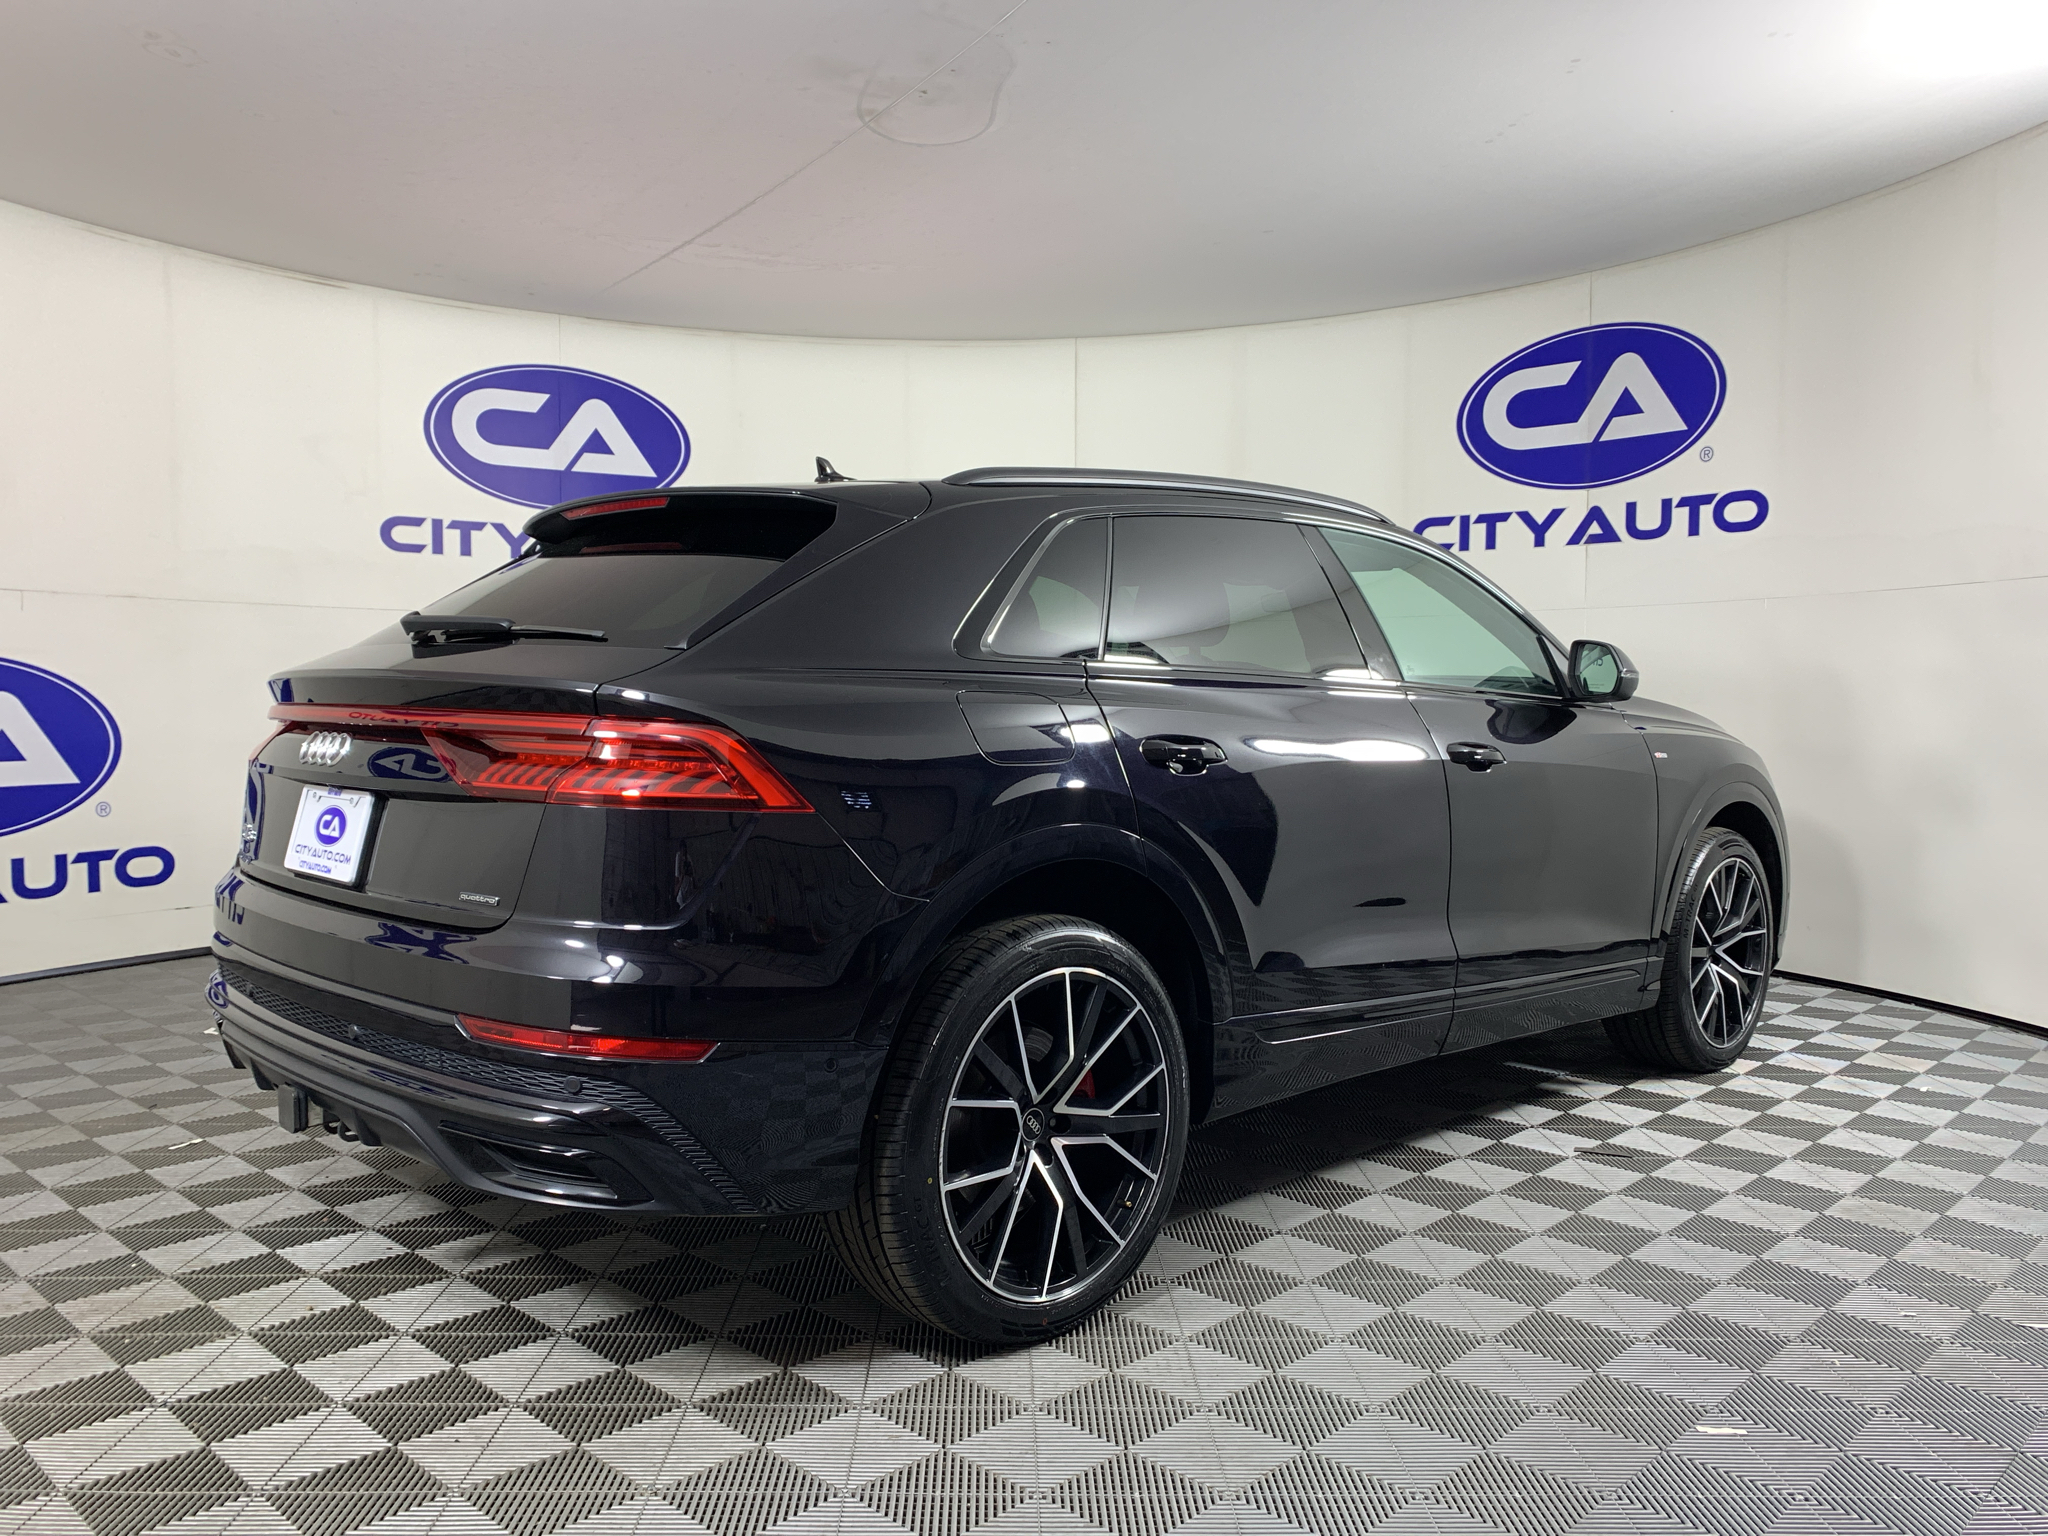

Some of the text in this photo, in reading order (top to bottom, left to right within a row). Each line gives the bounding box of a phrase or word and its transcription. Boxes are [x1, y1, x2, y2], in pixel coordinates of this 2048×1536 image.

[1482, 351, 1689, 451] CA
[451, 387, 658, 478] CA
[0, 845, 175, 904] UTO
[295, 844, 352, 865] CITYAUTO.COM
[460, 893, 497, 905] quattro
